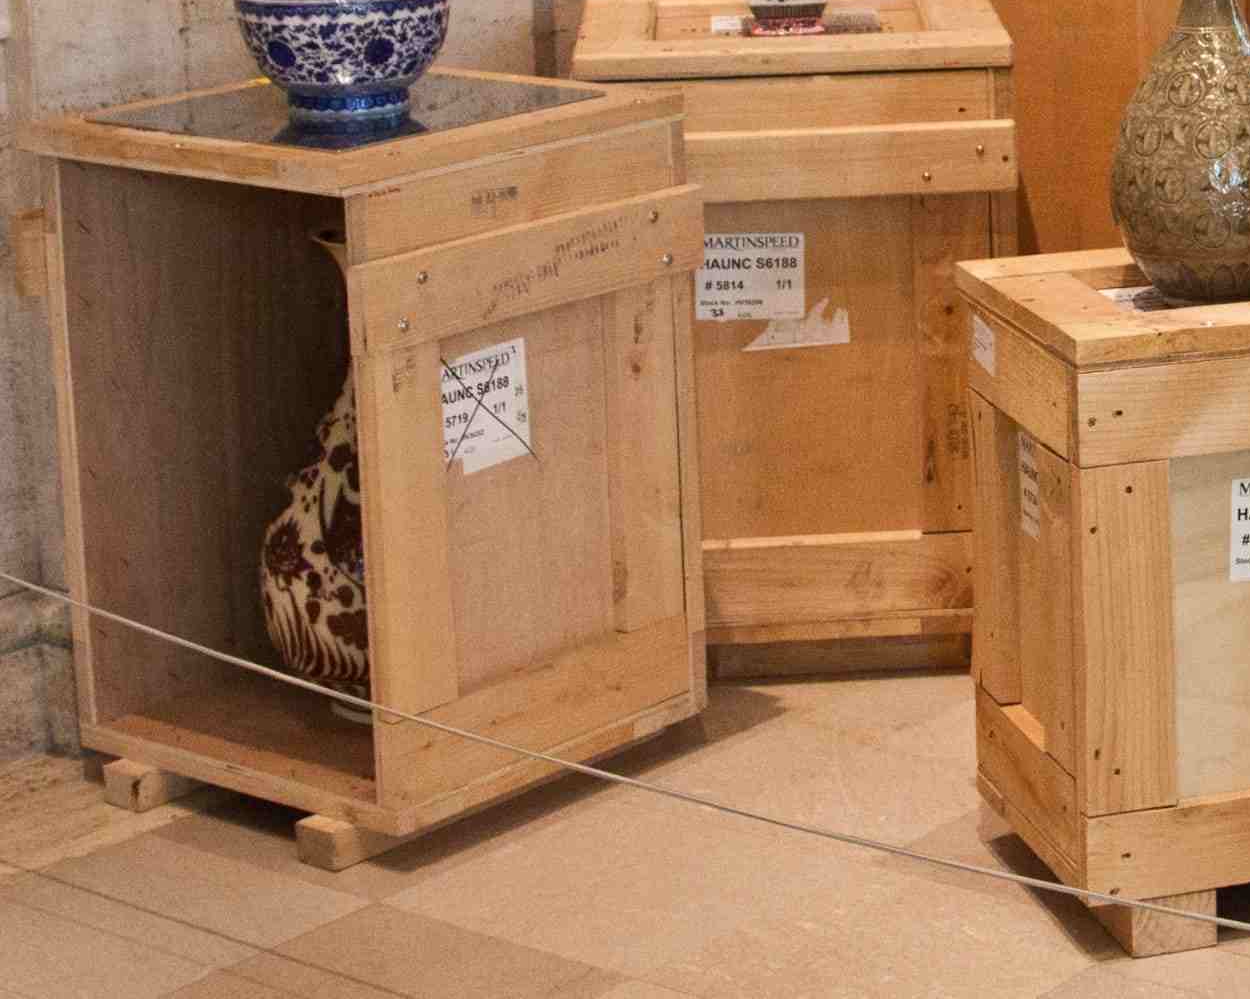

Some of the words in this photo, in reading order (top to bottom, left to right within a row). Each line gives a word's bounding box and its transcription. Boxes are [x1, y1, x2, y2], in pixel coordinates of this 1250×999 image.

[755, 256, 798, 270] S6188
[716, 279, 745, 291] 5814
[775, 279, 793, 290] 1/1
[441, 385, 475, 405] AUNC
[1241, 533, 1250, 545] #
